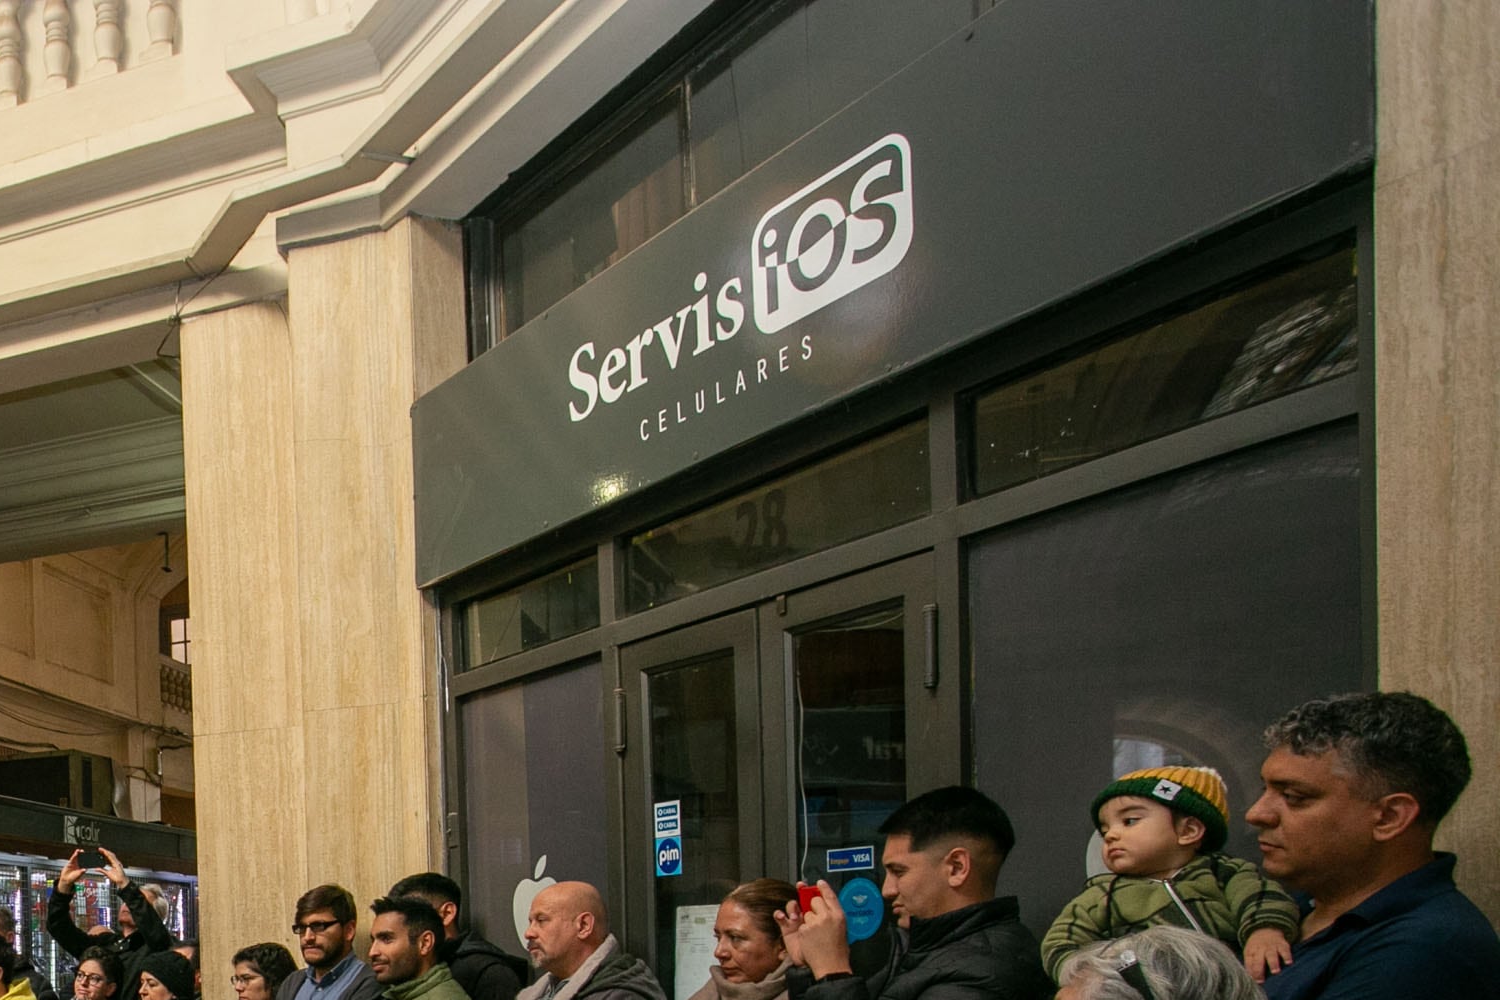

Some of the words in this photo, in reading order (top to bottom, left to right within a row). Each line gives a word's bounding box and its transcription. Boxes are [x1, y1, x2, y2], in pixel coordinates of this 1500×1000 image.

[568, 271, 745, 422] Servis
[640, 335, 813, 441] CELULARES
[659, 845, 679, 866] pim
[852, 853, 870, 863] VISA
